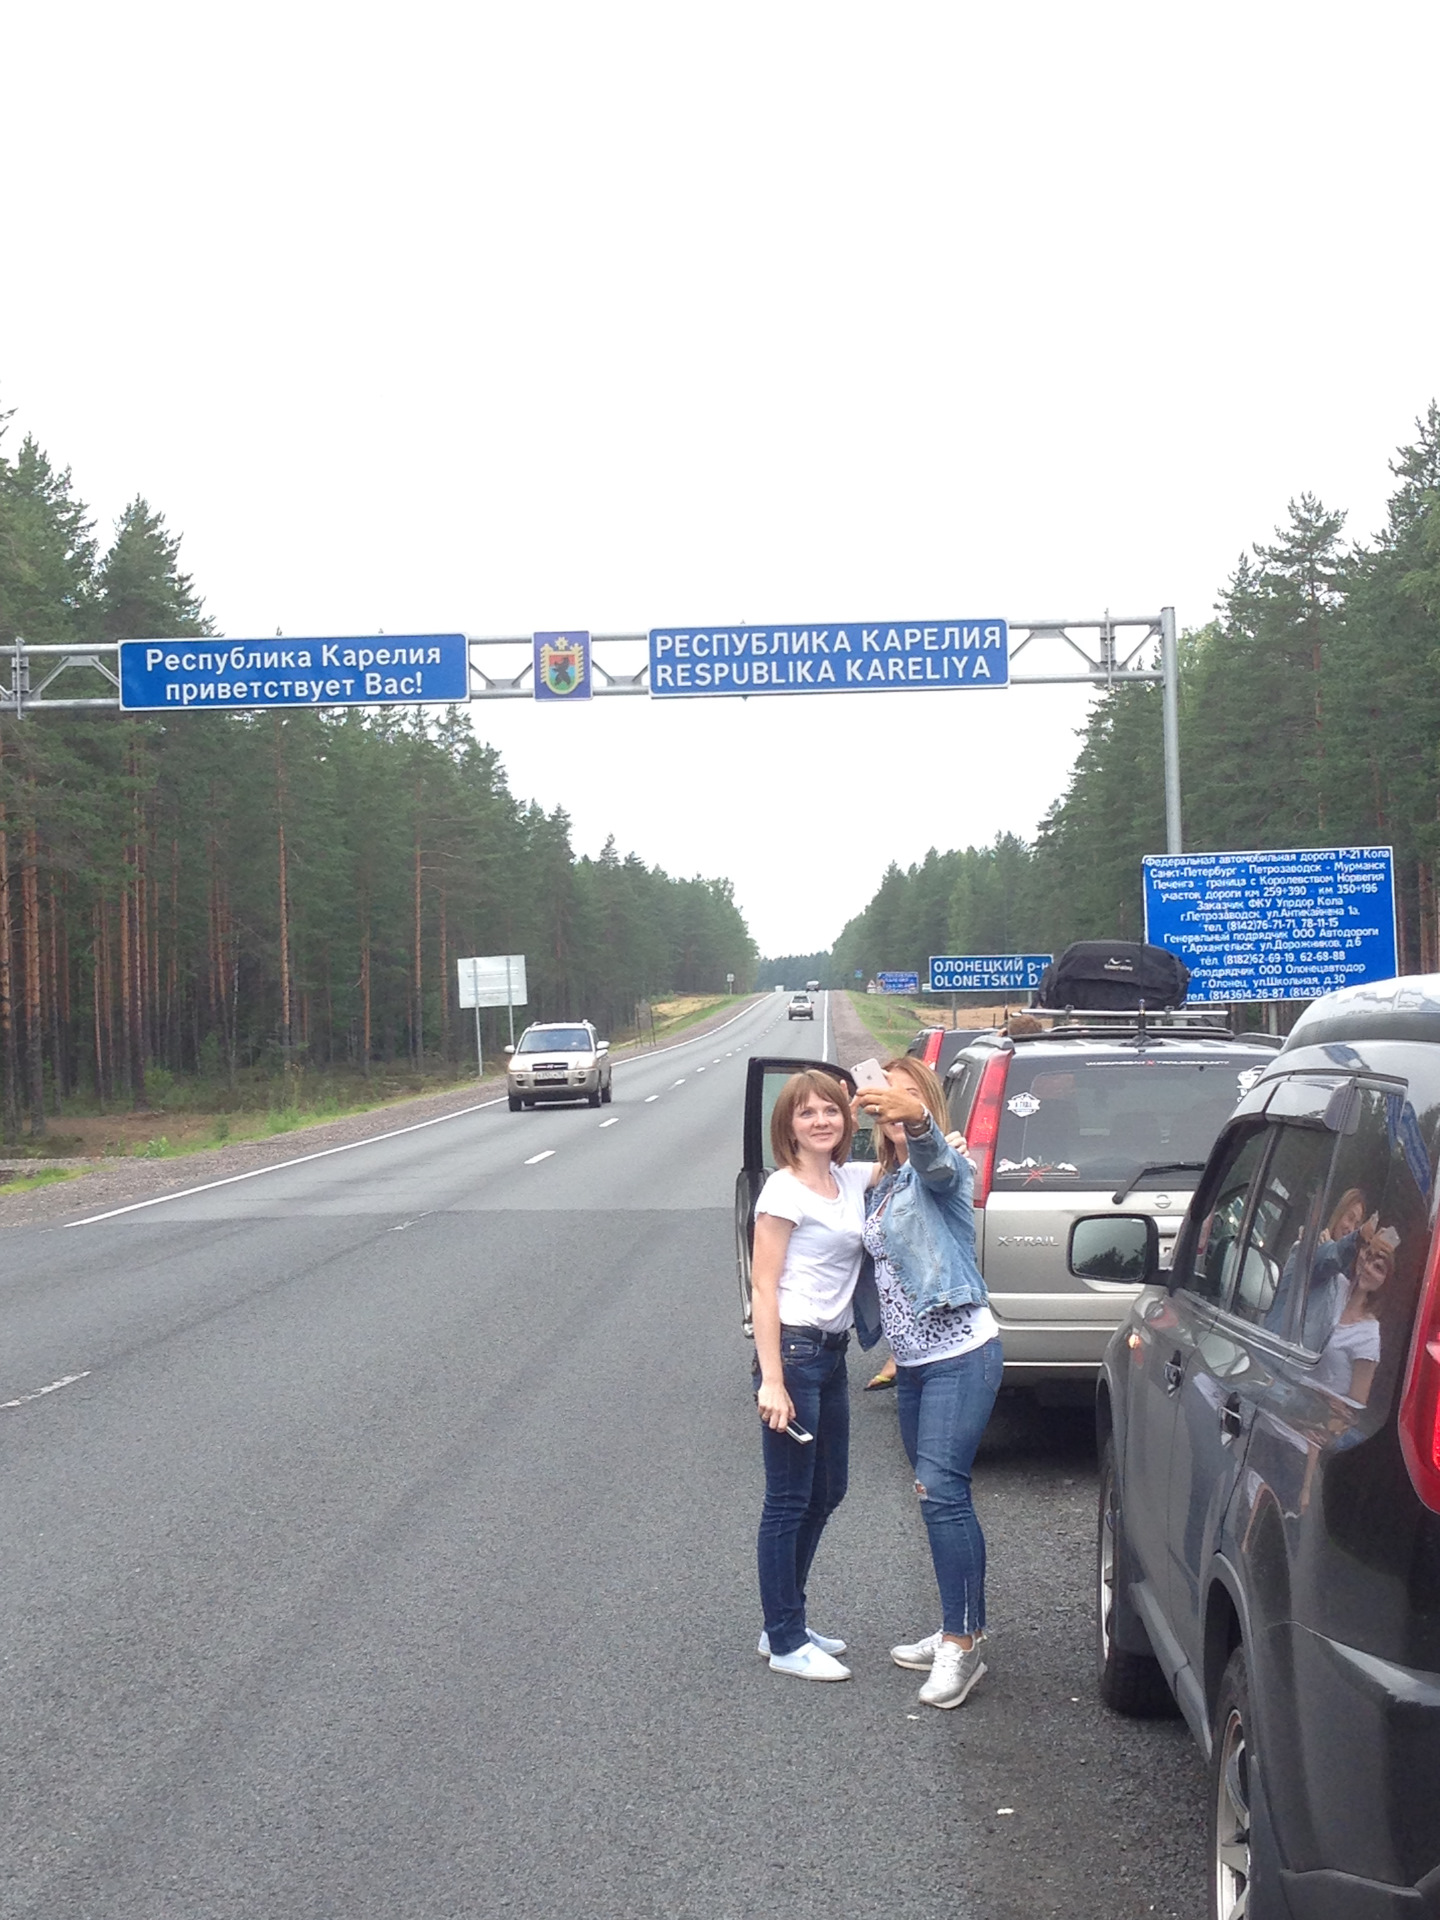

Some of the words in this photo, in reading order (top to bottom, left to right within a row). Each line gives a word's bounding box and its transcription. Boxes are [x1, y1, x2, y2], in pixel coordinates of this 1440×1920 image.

[656, 630, 852, 658] РЕСПУБЛИКА
[862, 626, 1001, 652] КАРЕЛИЯ
[146, 646, 312, 675] Республика
[322, 644, 441, 671] Карелия
[656, 660, 836, 687] RESPUBLIKA
[846, 655, 992, 681] KARELIYA
[165, 678, 355, 705] приветствует
[365, 672, 423, 696] Вас!
[1145, 857, 1216, 867] Федеральная
[1218, 854, 1297, 864] автомобильная
[1300, 851, 1336, 862] дорога
[1363, 849, 1390, 859] Кола
[1150, 866, 1238, 878] Санкт-Петербург
[1249, 864, 1322, 875] Петрозаводск
[1334, 862, 1386, 872] Мурманск
[1153, 879, 1195, 889] Печенга
[1206, 878, 1247, 888] граница
[1250, 878, 1256, 886] с
[1260, 875, 1334, 886] Королевством
[1337, 873, 1385, 883] Норвегия
[1161, 891, 1201, 903] участок
[1205, 890, 1242, 900] дороги
[1245, 890, 1260, 898] км
[1318, 887, 1334, 895] км
[1196, 900, 1244, 910] Заказчик
[1248, 898, 1272, 908] ФКУ
[1276, 898, 1315, 909] Упрдор
[1317, 896, 1344, 906] Кола
[1301, 917, 1339, 929] 78-11-15
[1163, 932, 1230, 943] Генеральный
[1233, 931, 1289, 942] подрядчик
[1292, 928, 1316, 939] ООО
[1319, 928, 1379, 938] Автодороги
[933, 957, 1024, 973] ОЛОНЕЦКИЙ
[1259, 964, 1282, 975] ООО
[1285, 963, 1366, 974] Олонецавтодор
[934, 973, 1024, 987] OLONETSKIY
[997, 1235, 1060, 1247] X-TRAIL
